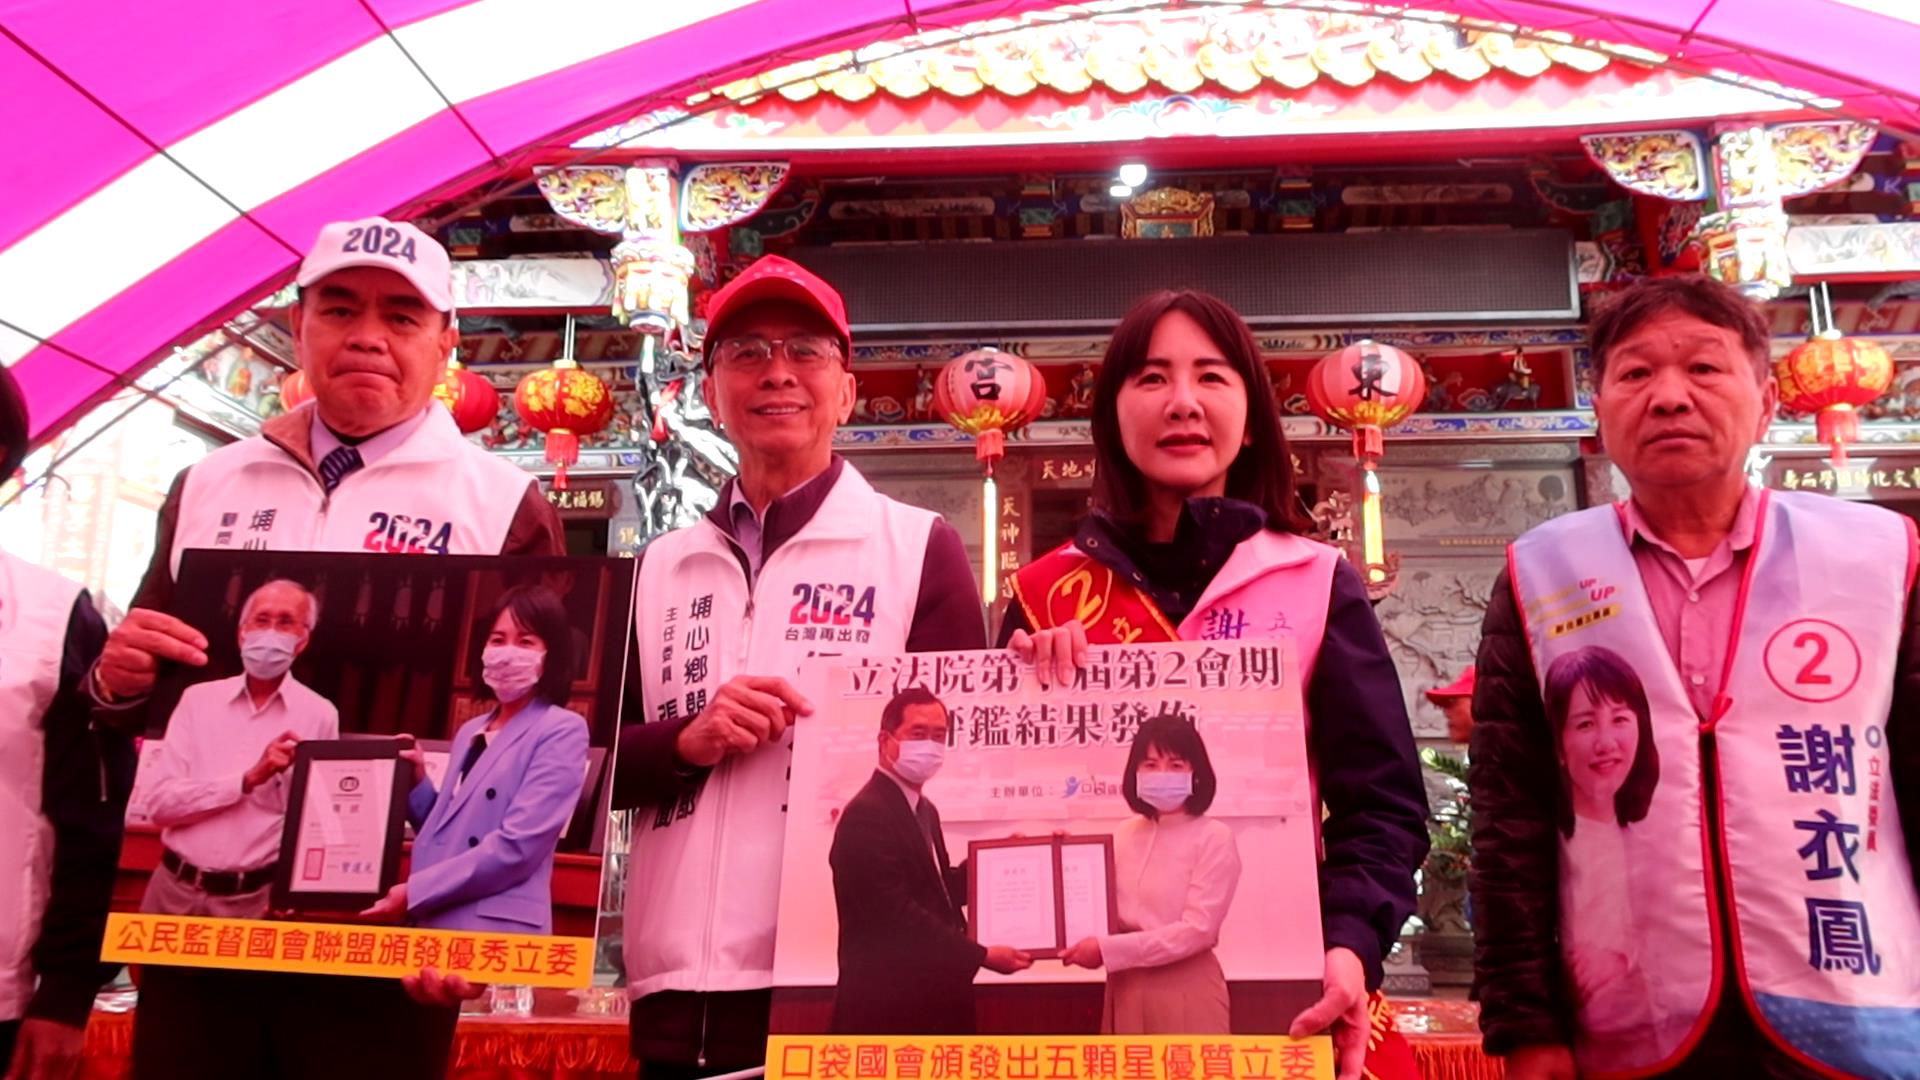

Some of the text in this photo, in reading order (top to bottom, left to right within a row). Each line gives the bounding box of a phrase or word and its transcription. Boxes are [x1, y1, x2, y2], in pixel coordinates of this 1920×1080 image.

[342, 224, 417, 264] 2024
[965, 357, 1014, 401] 宮
[1348, 353, 1399, 402] 東
[362, 511, 453, 555] 2024
[788, 583, 877, 628] 2024
[1590, 586, 1616, 602] UP
[784, 626, 871, 644] 台灣再出發
[1201, 607, 1250, 641] 謝
[843, 646, 1281, 698] 立法院第屆第2會期
[1775, 723, 1881, 976] 謝衣鳳
[116, 920, 578, 977] 公民監督國會聯盟頒發優秀立委
[781, 1043, 1316, 1080] 口袋國會頒發出五顆星優質立委
